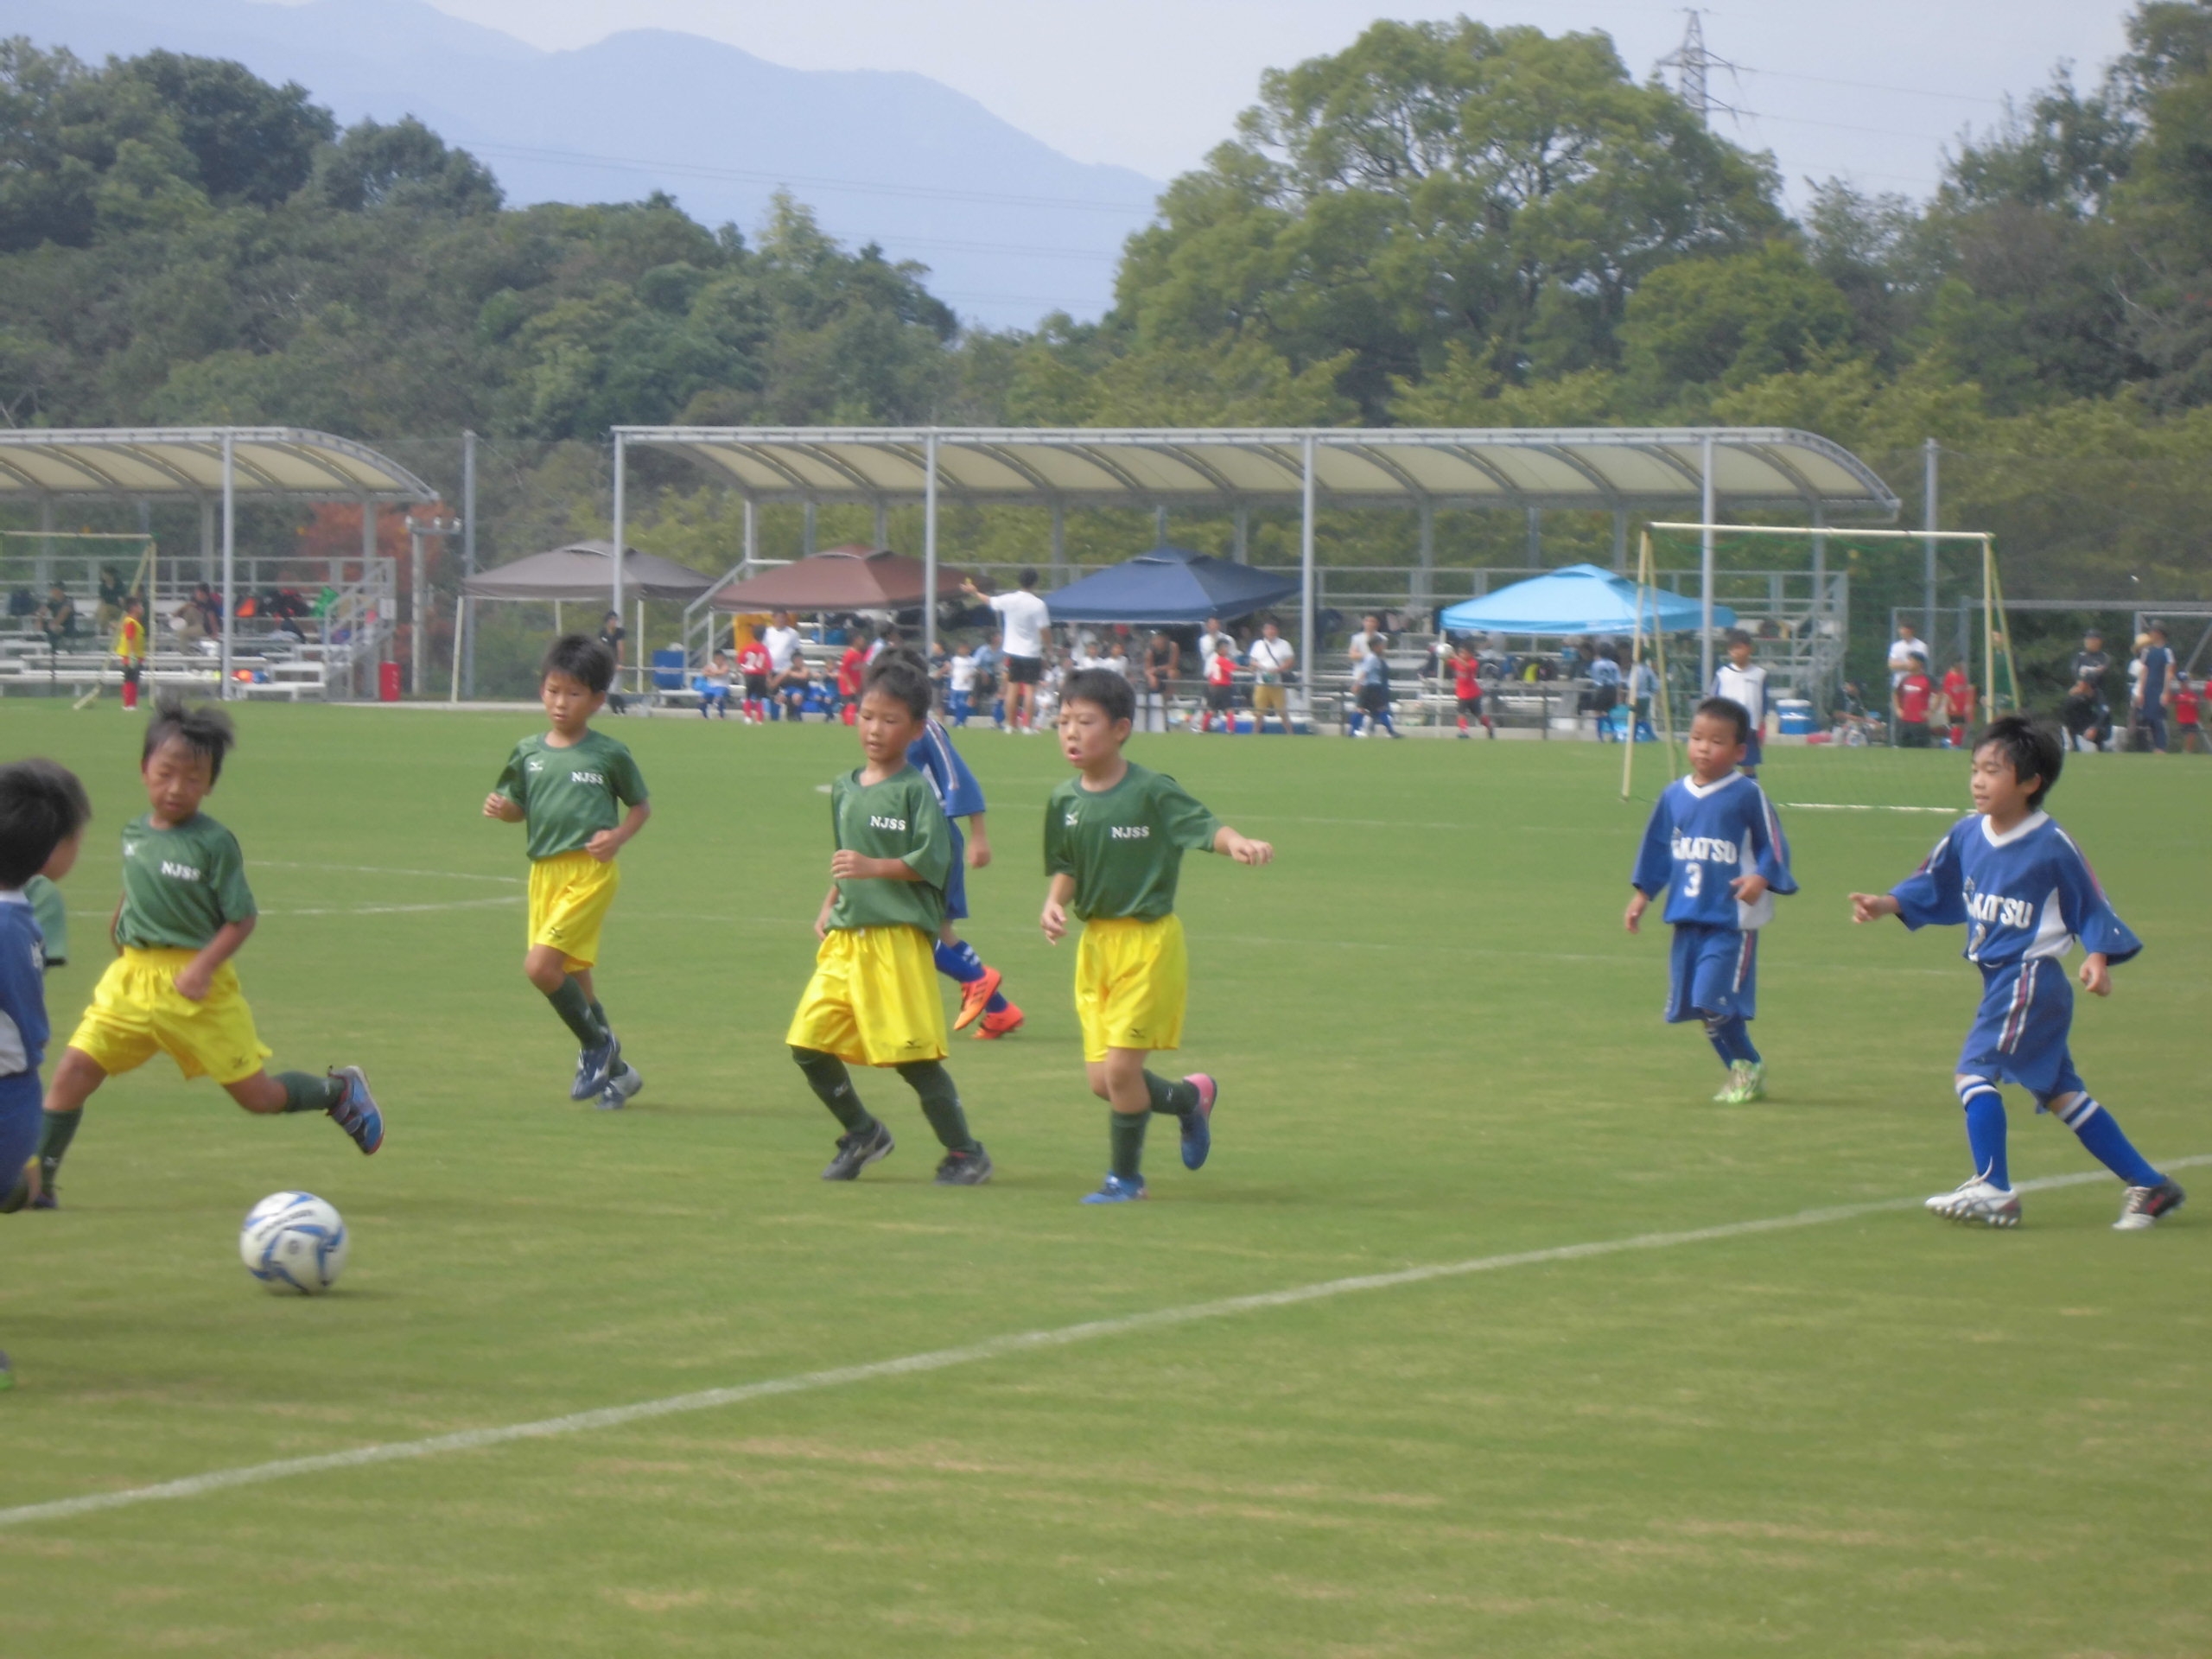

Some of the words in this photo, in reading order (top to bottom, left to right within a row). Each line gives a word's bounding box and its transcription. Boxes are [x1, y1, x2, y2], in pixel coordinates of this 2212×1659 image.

[571, 771, 604, 785] NJSS
[870, 815, 906, 831] NJSS
[1111, 825, 1150, 839] NJSS
[162, 861, 201, 881] NJSS
[1683, 862, 1701, 898] 3
